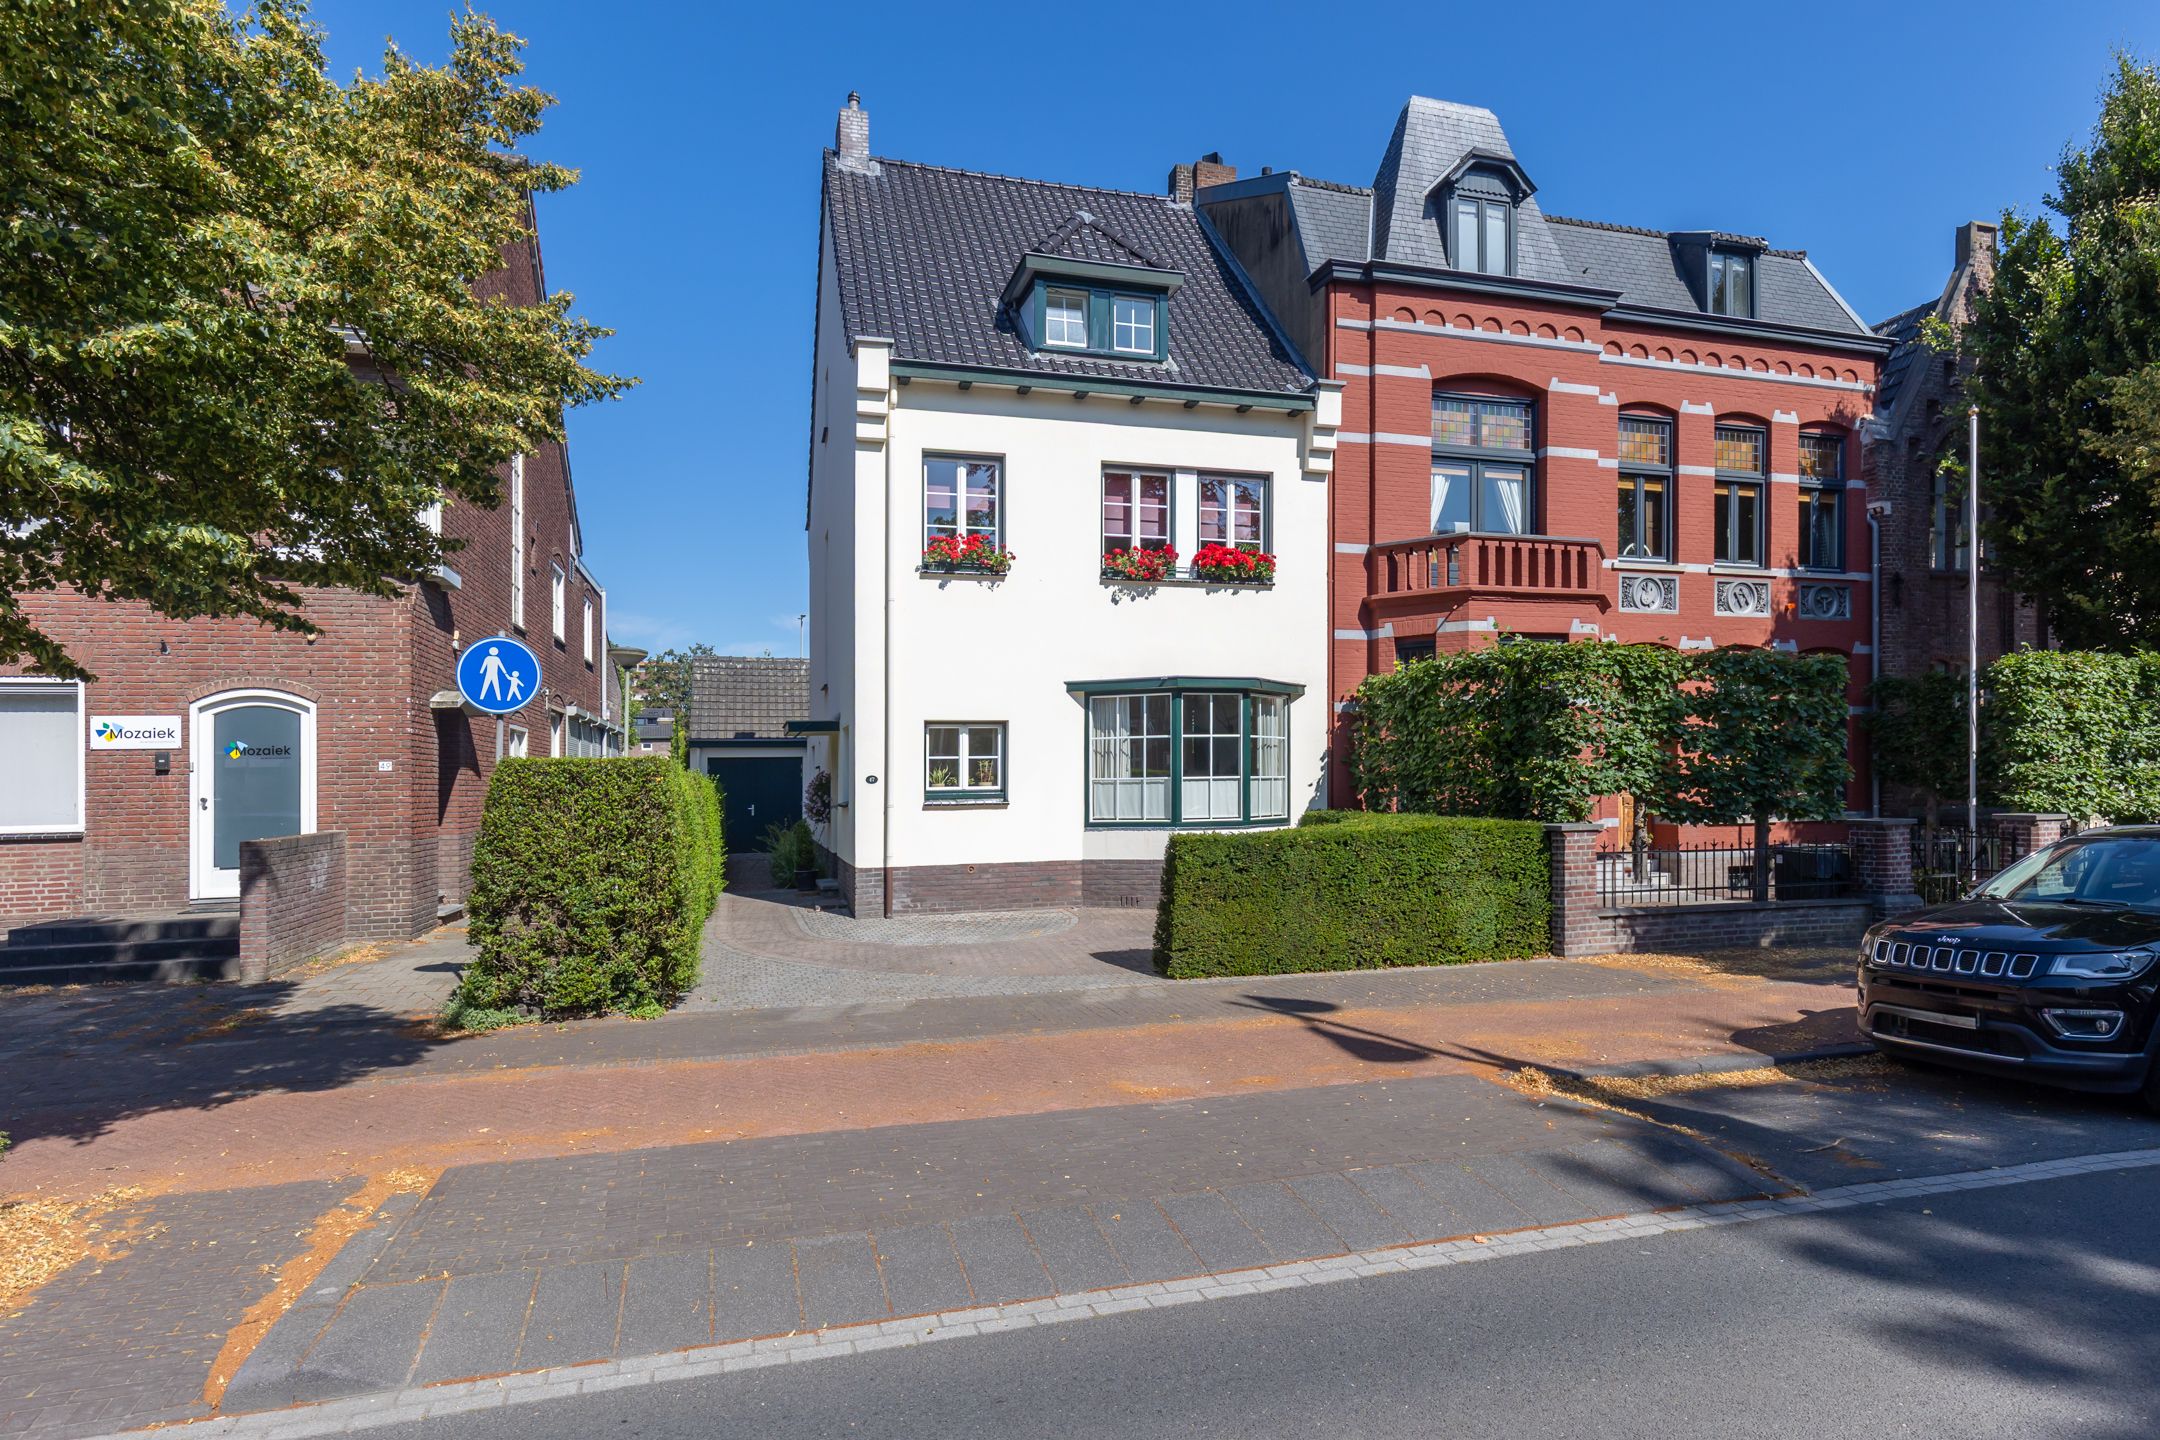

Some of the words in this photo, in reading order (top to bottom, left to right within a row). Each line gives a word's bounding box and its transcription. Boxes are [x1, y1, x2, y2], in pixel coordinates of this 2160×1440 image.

[110, 727, 175, 739] Mozaiek
[235, 745, 291, 756] Mozaiek
[1937, 935, 1960, 944] Jeep
